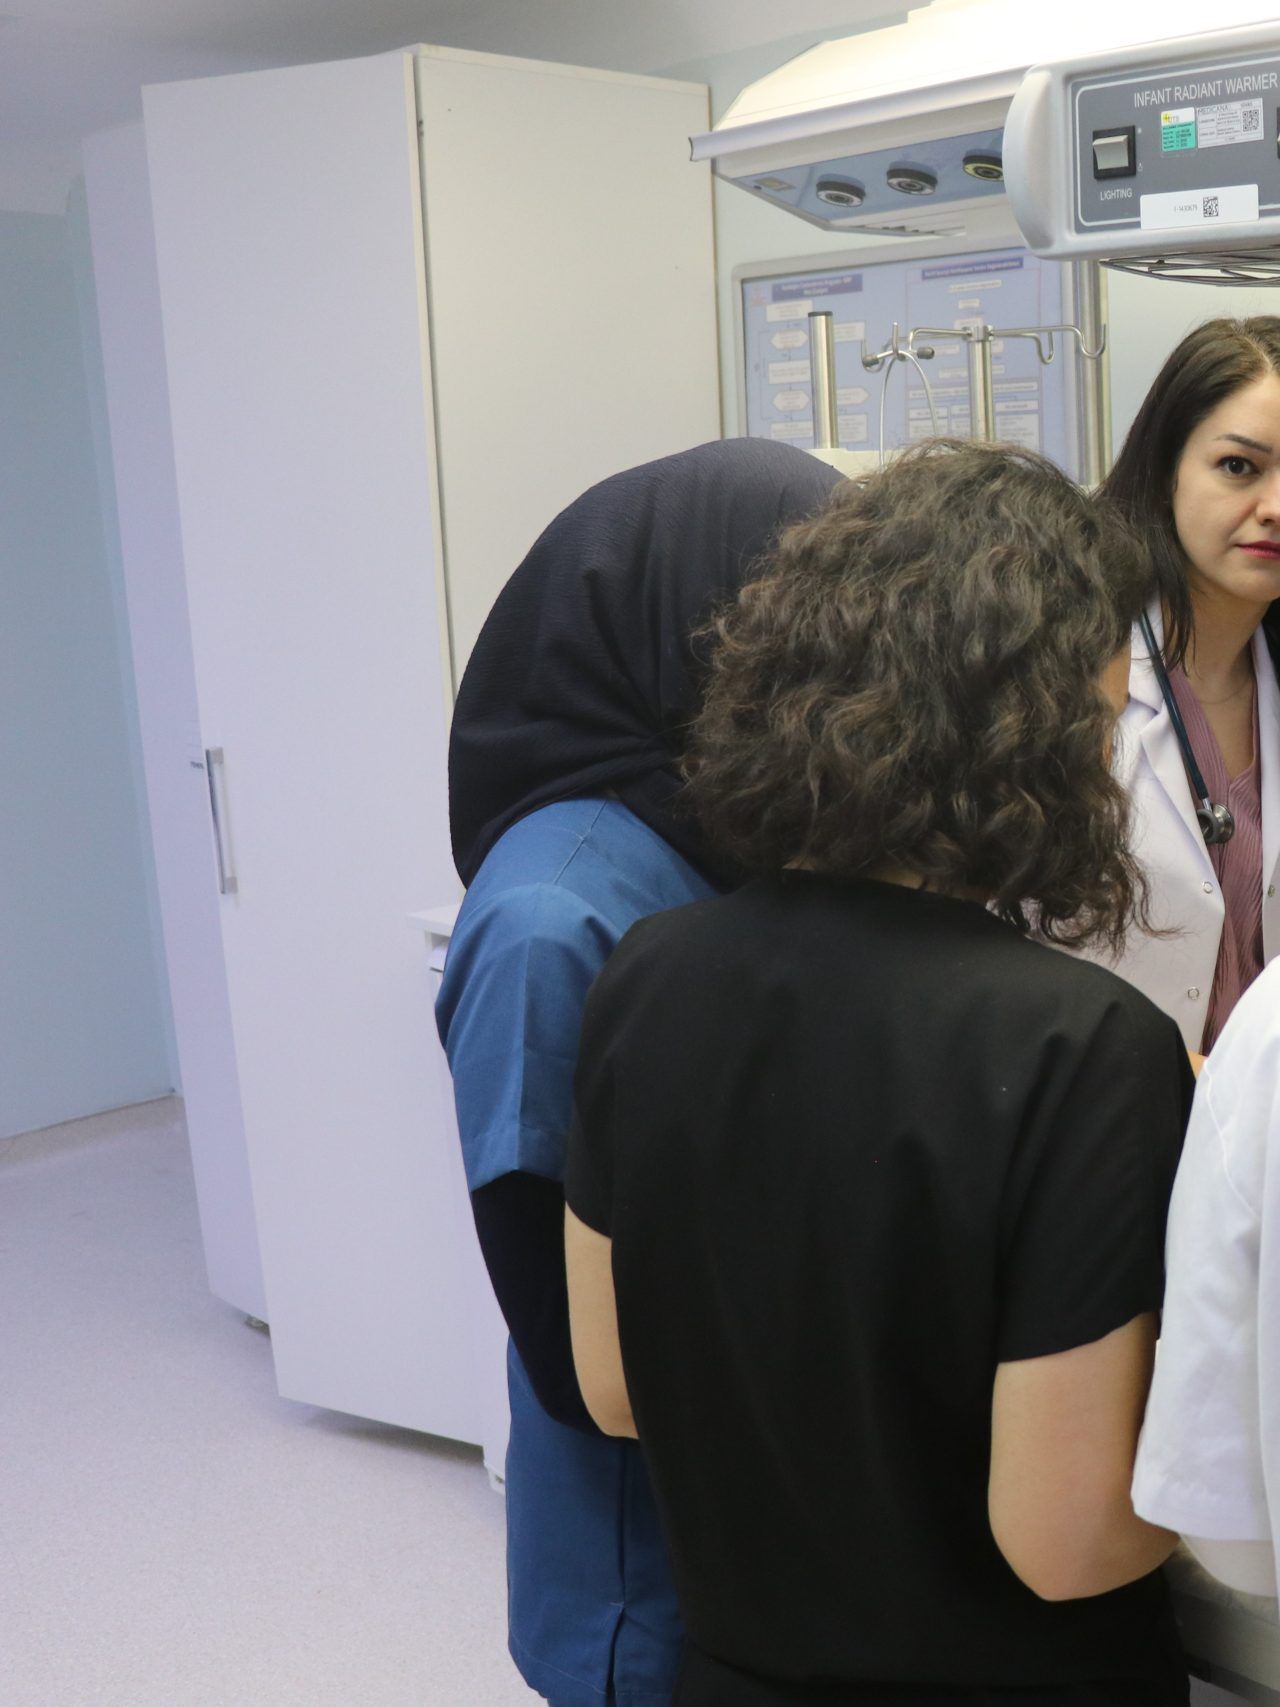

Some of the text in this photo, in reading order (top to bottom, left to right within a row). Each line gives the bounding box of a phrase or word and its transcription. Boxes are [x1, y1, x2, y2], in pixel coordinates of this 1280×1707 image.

[1134, 72, 1279, 108] INFANT RADIANT WARMER
[1100, 187, 1133, 201] LIGHTING
